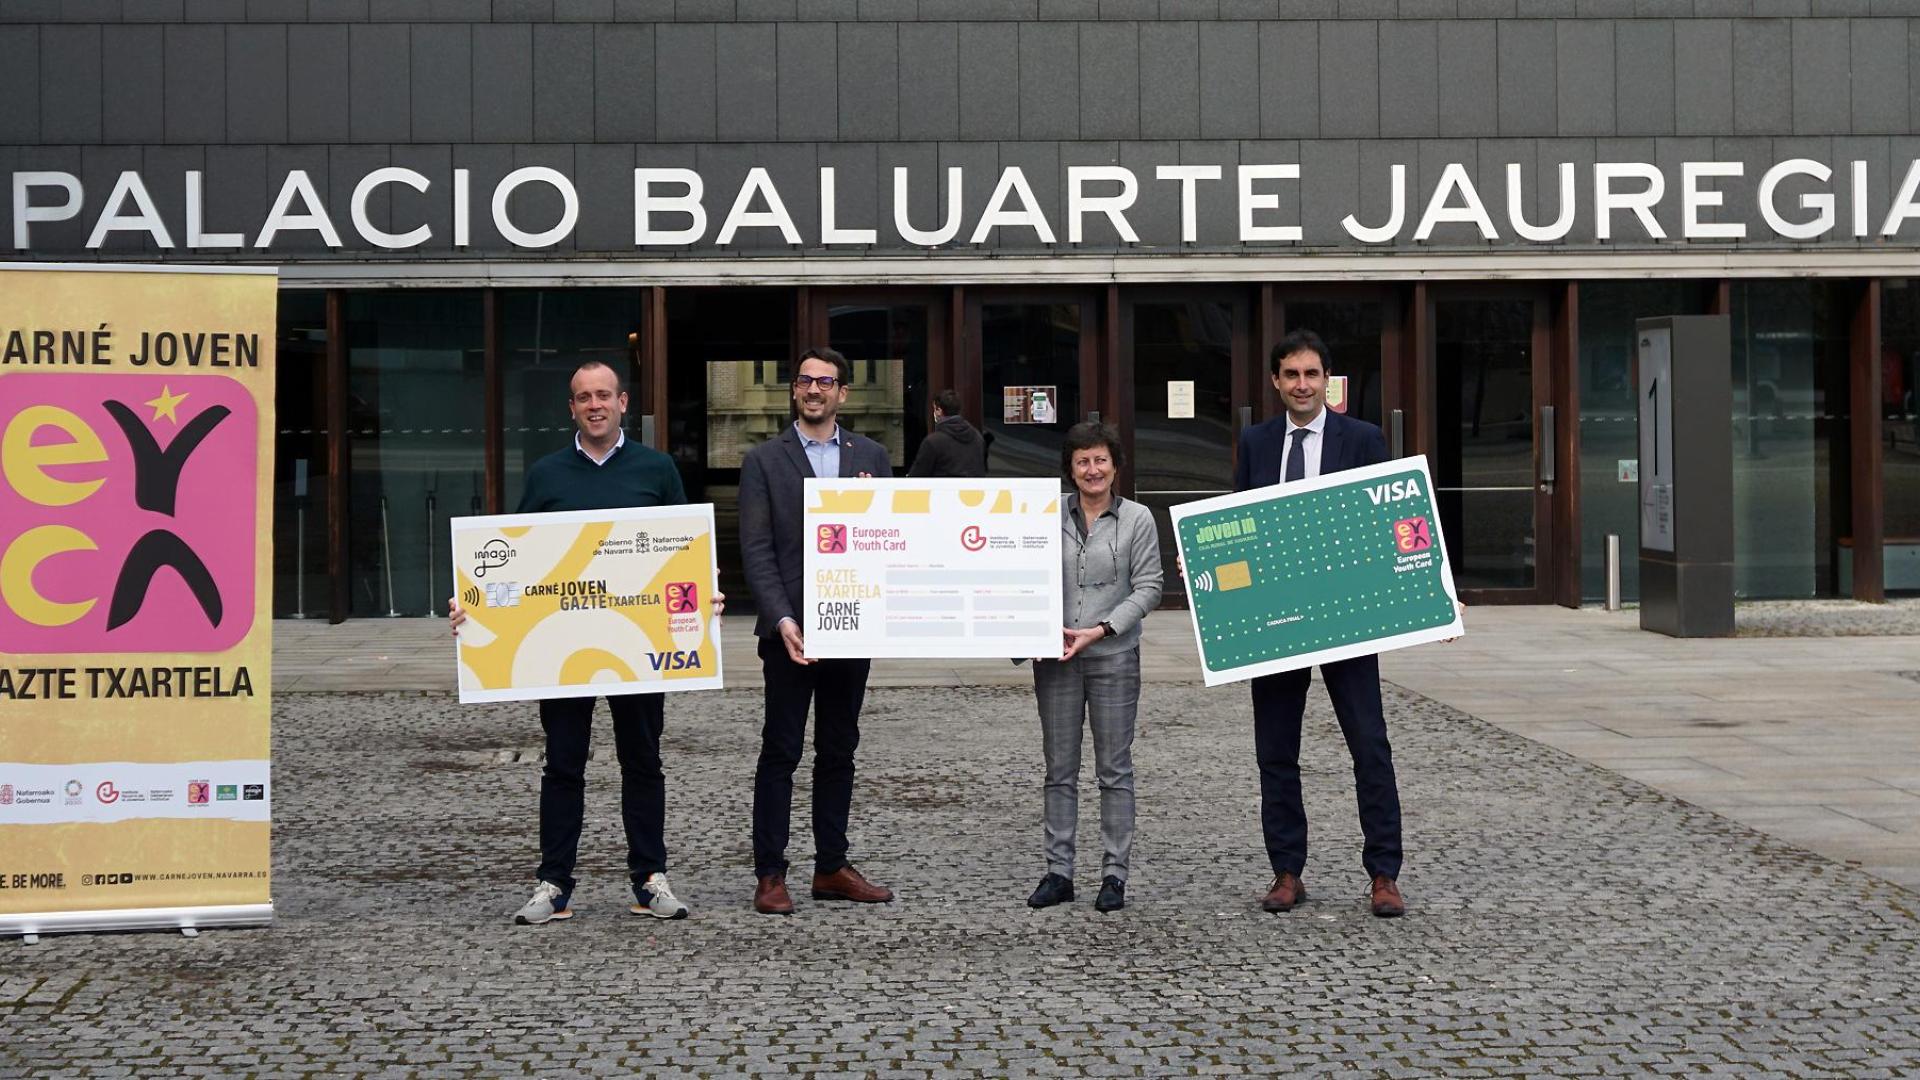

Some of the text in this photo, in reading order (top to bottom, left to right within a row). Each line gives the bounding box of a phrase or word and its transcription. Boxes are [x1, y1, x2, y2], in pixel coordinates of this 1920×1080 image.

[12, 166, 579, 249] PALACIO
[634, 164, 1304, 246] BALUARTE
[1, 323, 259, 367] ARNÉ JOVEN
[1361, 477, 1422, 506] VISA
[652, 535, 694, 544] Nafarroako
[852, 526, 900, 540] European
[598, 538, 633, 547] Gobierno
[652, 545, 690, 553] Gobernua
[852, 540, 906, 551] Youth Card
[604, 547, 634, 555] Navarra
[1397, 552, 1430, 564] European
[1393, 558, 1432, 573] Youth Card
[816, 569, 857, 584] GAZTE
[560, 580, 607, 597] JOVEN
[816, 584, 882, 599] TXARTELA
[560, 593, 661, 611] GAZTE TXARTELA
[817, 600, 861, 616] CARNÉ
[668, 617, 697, 626] European
[817, 616, 860, 631] JOVEN
[644, 650, 702, 671] VISA
[0, 666, 254, 700] AZTE TXARTELA
[12, 874, 27, 888] BE
[30, 873, 66, 889] MORE.
